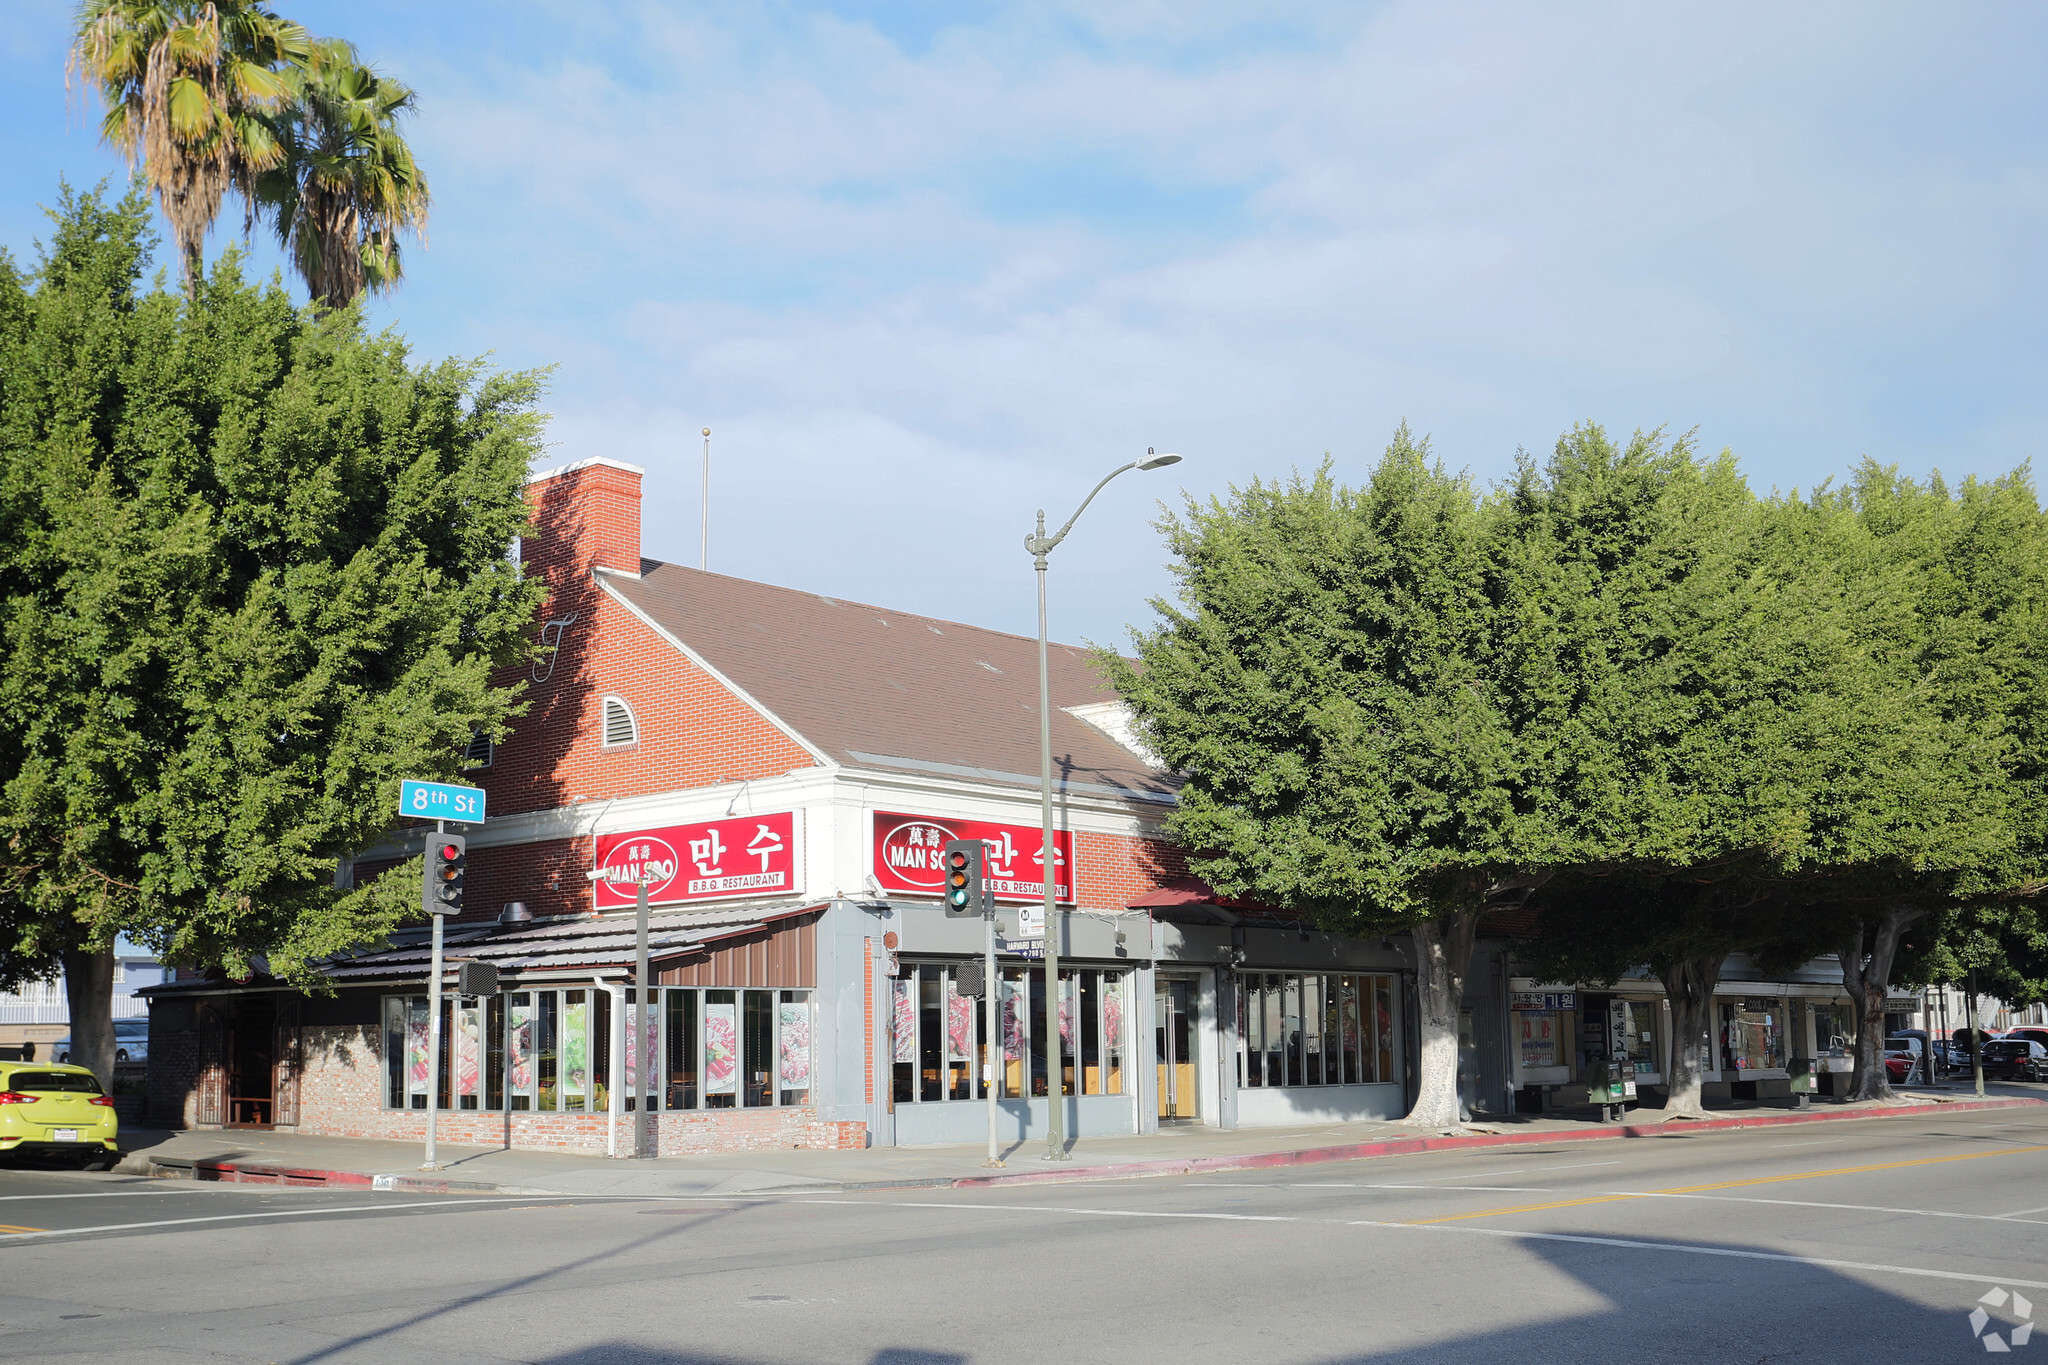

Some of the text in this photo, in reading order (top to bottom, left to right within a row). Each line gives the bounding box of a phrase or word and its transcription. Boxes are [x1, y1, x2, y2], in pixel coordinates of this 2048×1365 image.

[413, 788, 476, 813] 8th St
[907, 826, 940, 848] 萬壽
[629, 844, 651, 861] 萬壽
[891, 846, 926, 869] MAN
[609, 863, 640, 884] MAN
[693, 873, 780, 892] B.B.Q. RESTAURANT
[1013, 882, 1065, 897] RESTAUNT
[1006, 941, 1030, 951] HARVARD
[1028, 949, 1038, 957] 700
